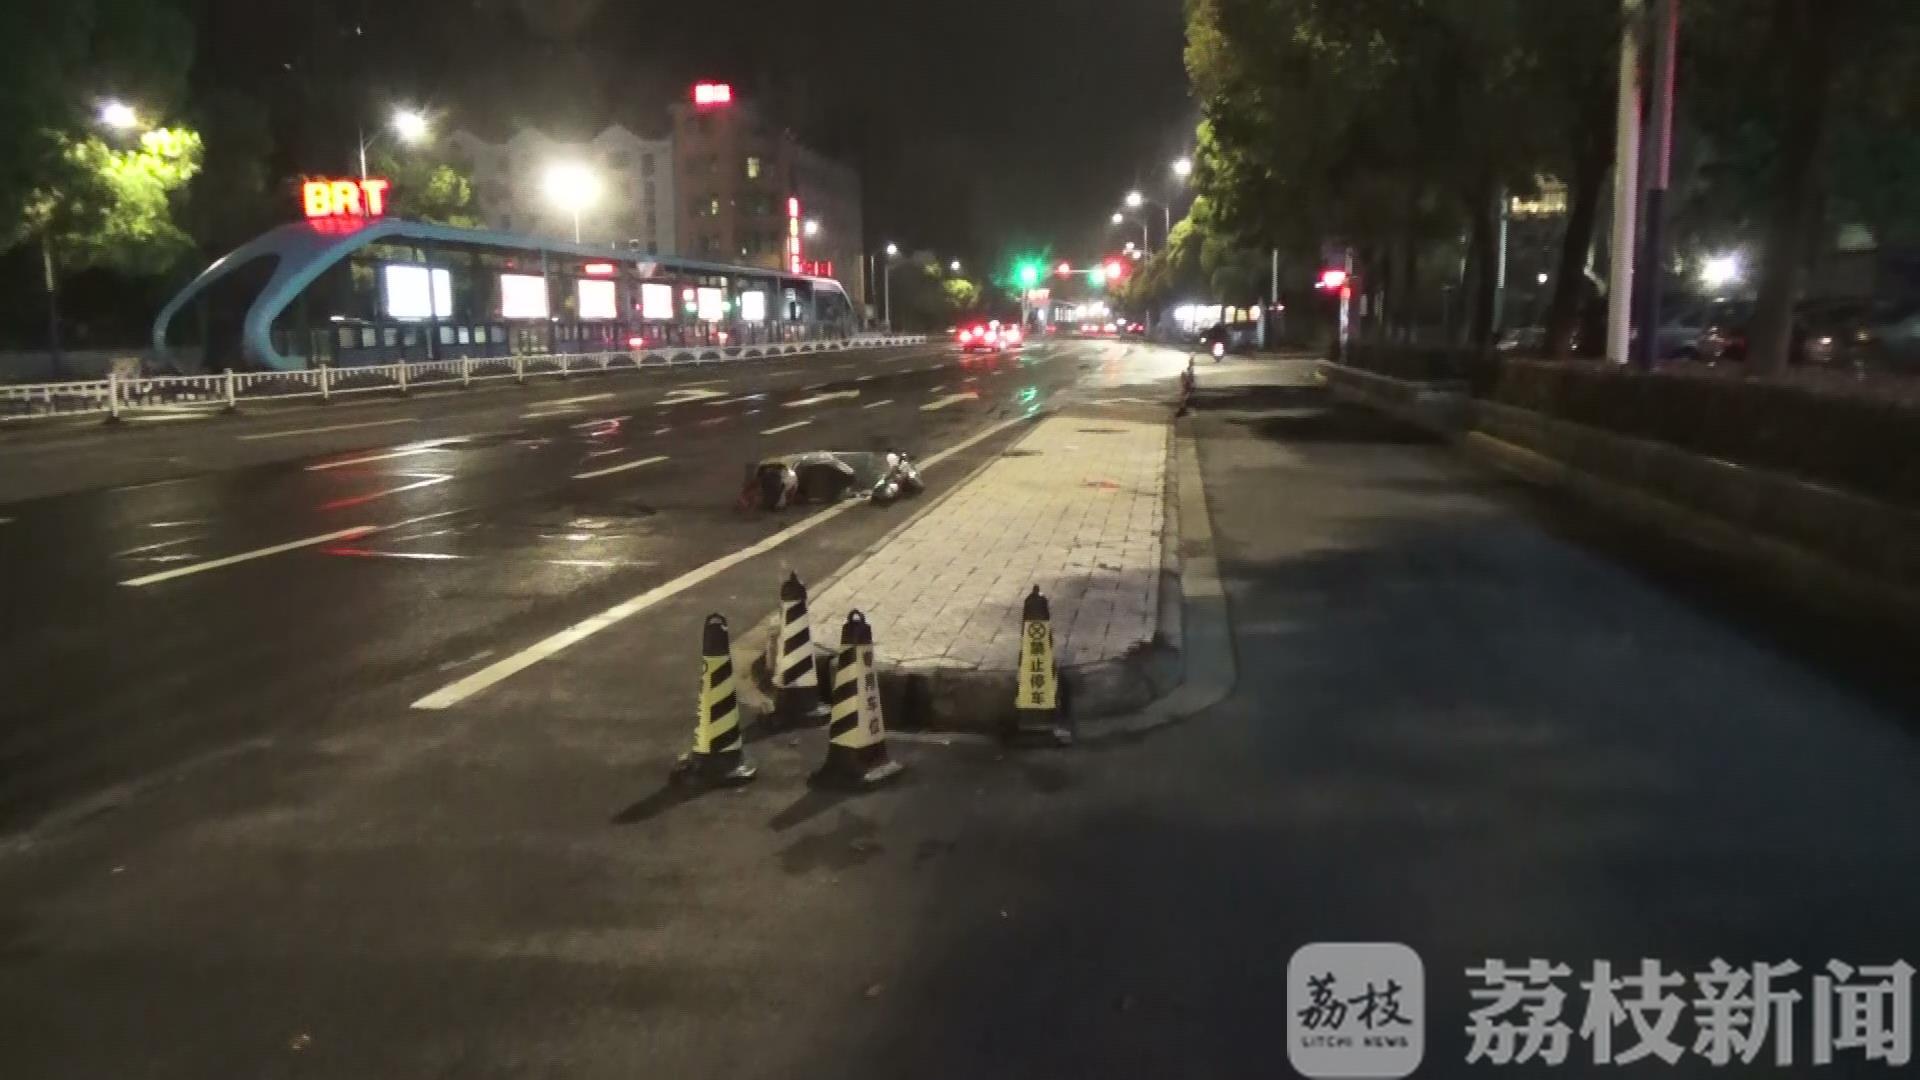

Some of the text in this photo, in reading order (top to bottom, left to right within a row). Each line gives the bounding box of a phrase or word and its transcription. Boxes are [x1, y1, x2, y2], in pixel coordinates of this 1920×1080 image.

[302, 179, 389, 217] BRT
[1029, 640, 1046, 705] 禁止停车
